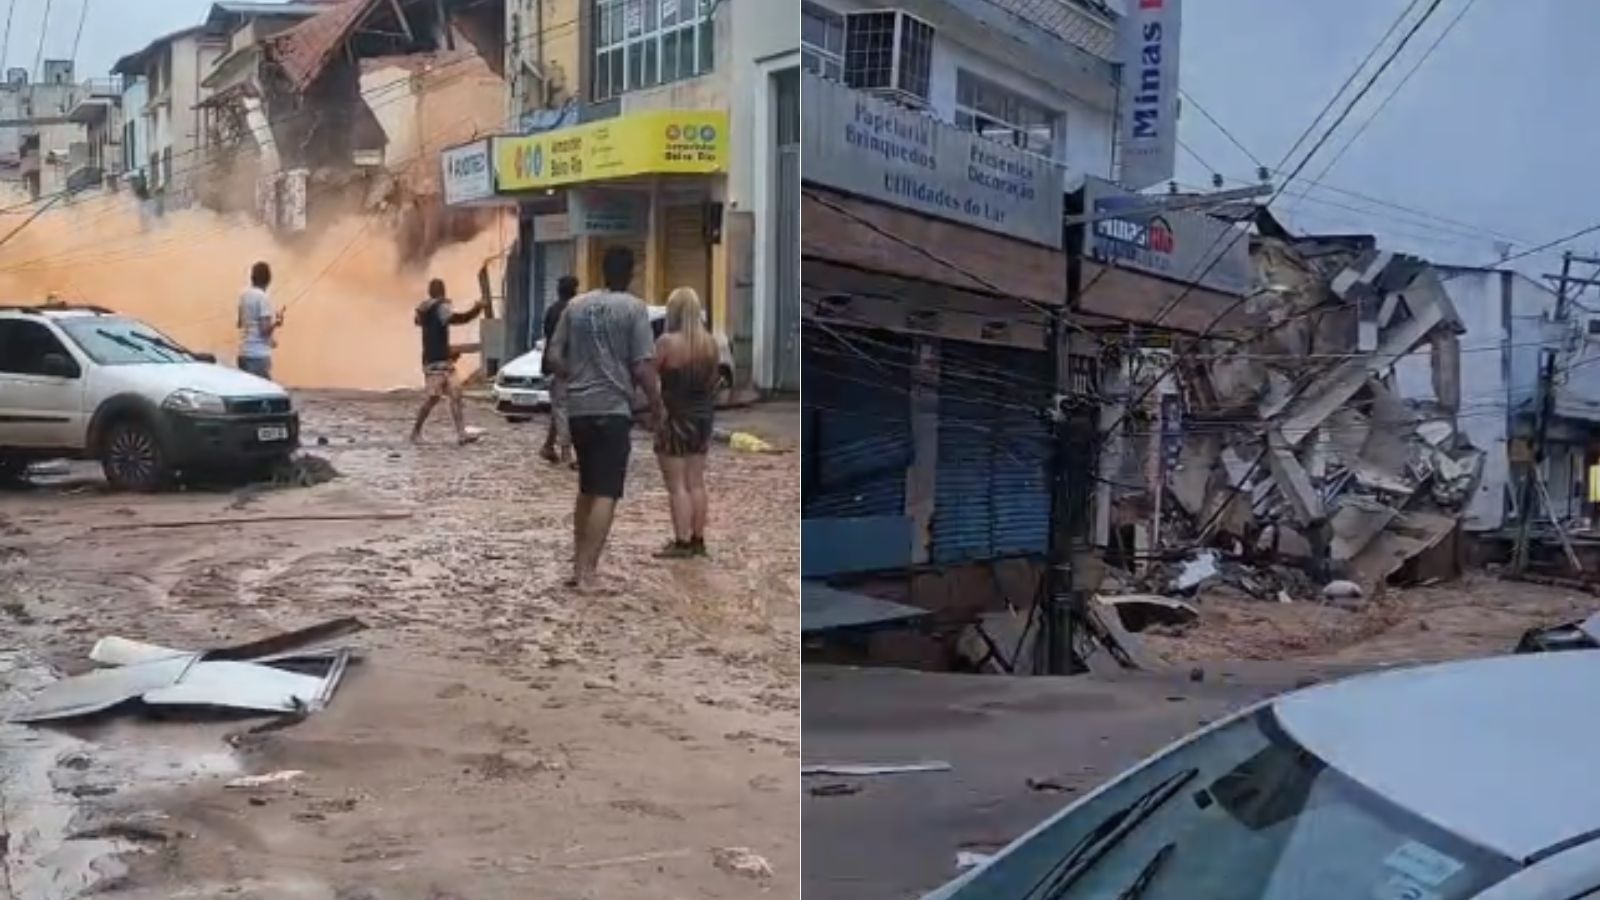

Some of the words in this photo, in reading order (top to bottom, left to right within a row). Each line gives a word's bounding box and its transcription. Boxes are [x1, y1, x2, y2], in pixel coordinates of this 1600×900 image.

[1132, 22, 1162, 138] Minas
[846, 124, 937, 170] Brinquedos
[855, 100, 928, 147] Papelaria
[884, 171, 960, 210] Utilidades
[964, 196, 981, 216] do
[985, 203, 1005, 223] Lar
[968, 164, 1035, 202] Decoração
